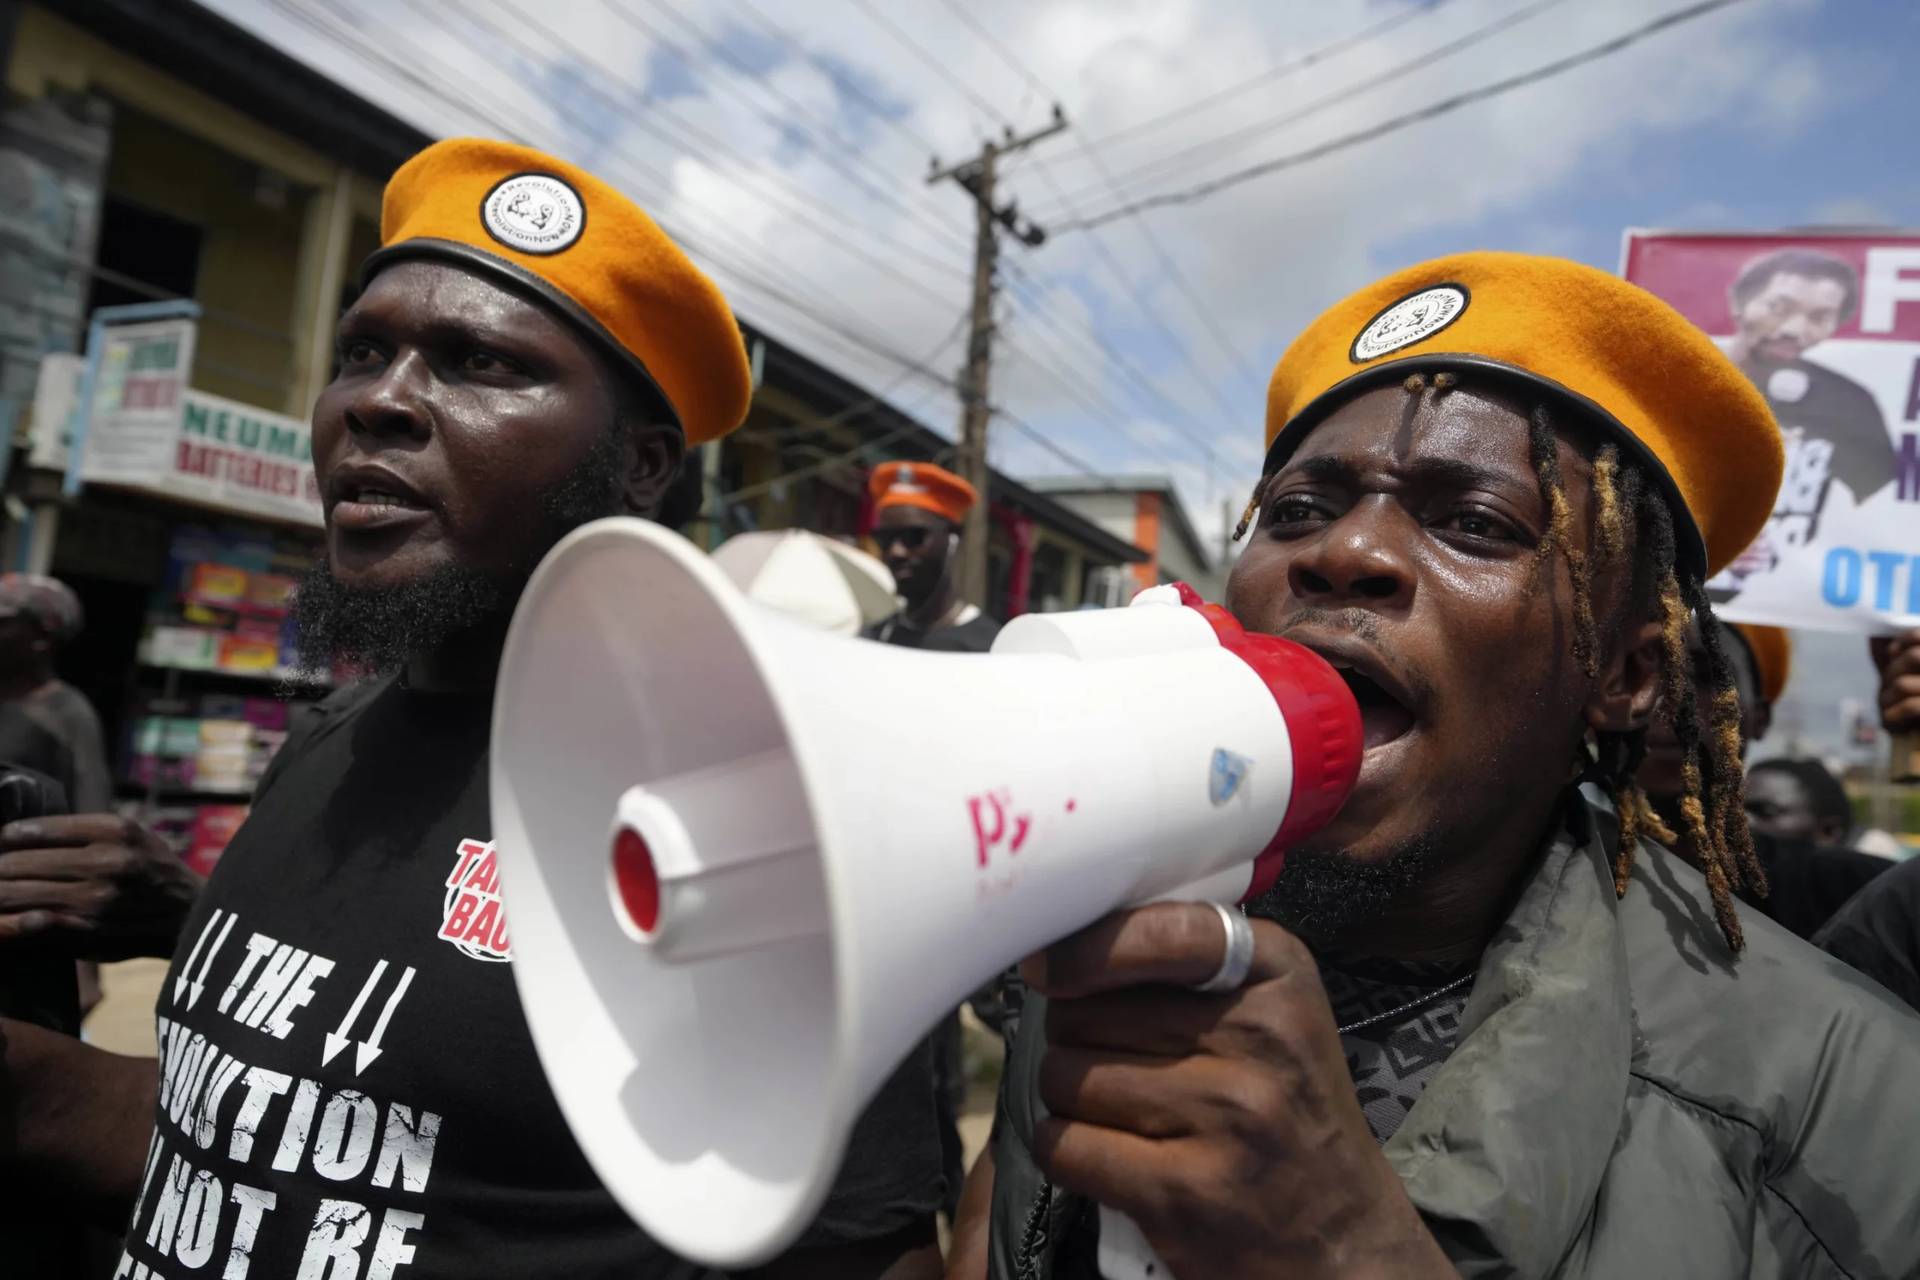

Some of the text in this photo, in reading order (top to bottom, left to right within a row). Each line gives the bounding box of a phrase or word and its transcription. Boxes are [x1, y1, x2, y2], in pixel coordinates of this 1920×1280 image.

[176, 440, 298, 496] BATTERIES
[217, 932, 336, 1040] THE
[145, 1152, 277, 1280] NOT
[295, 1198, 426, 1280] BE
